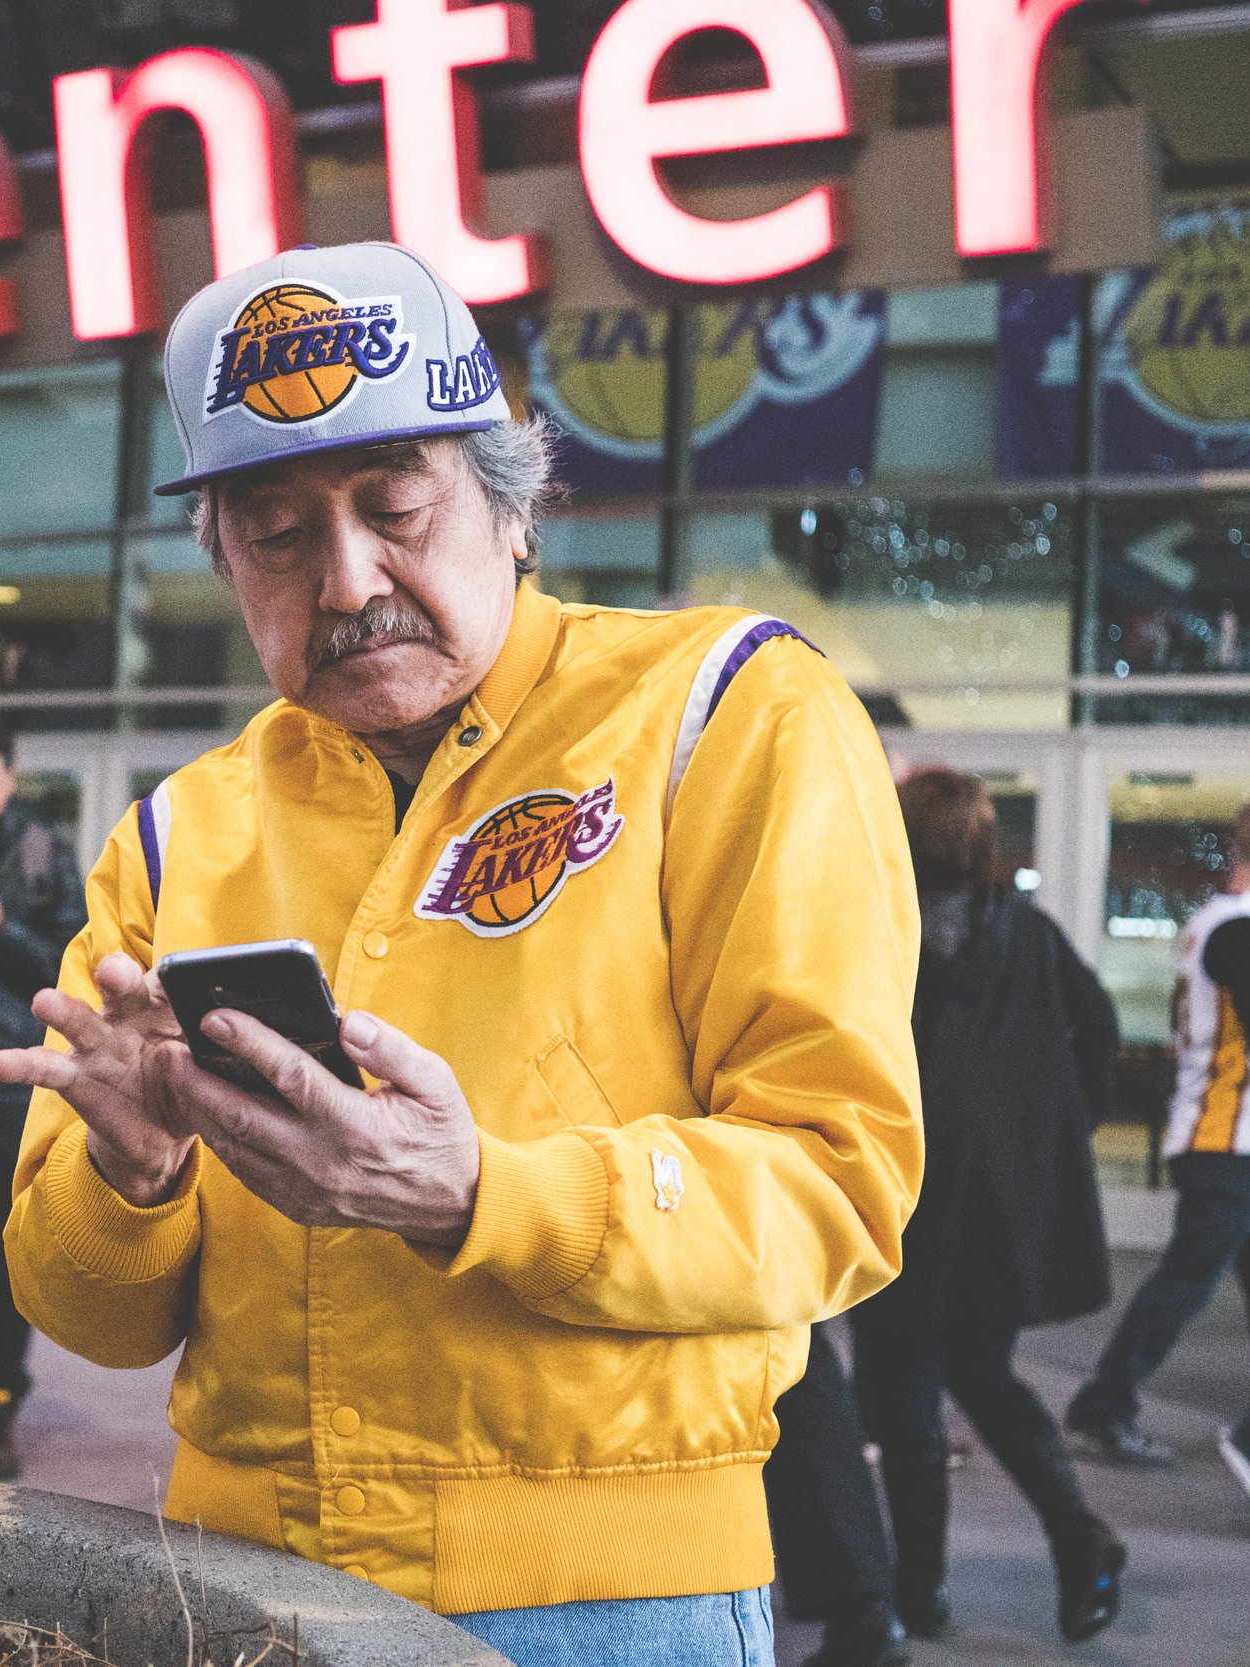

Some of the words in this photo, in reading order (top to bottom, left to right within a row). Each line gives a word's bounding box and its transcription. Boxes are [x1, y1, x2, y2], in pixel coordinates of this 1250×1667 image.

[253, 315, 293, 339] LOS
[291, 303, 393, 329] ANGELES
[206, 317, 410, 413] LAKERS
[421, 799, 623, 915] LAKERS
[490, 825, 534, 850] LOS
